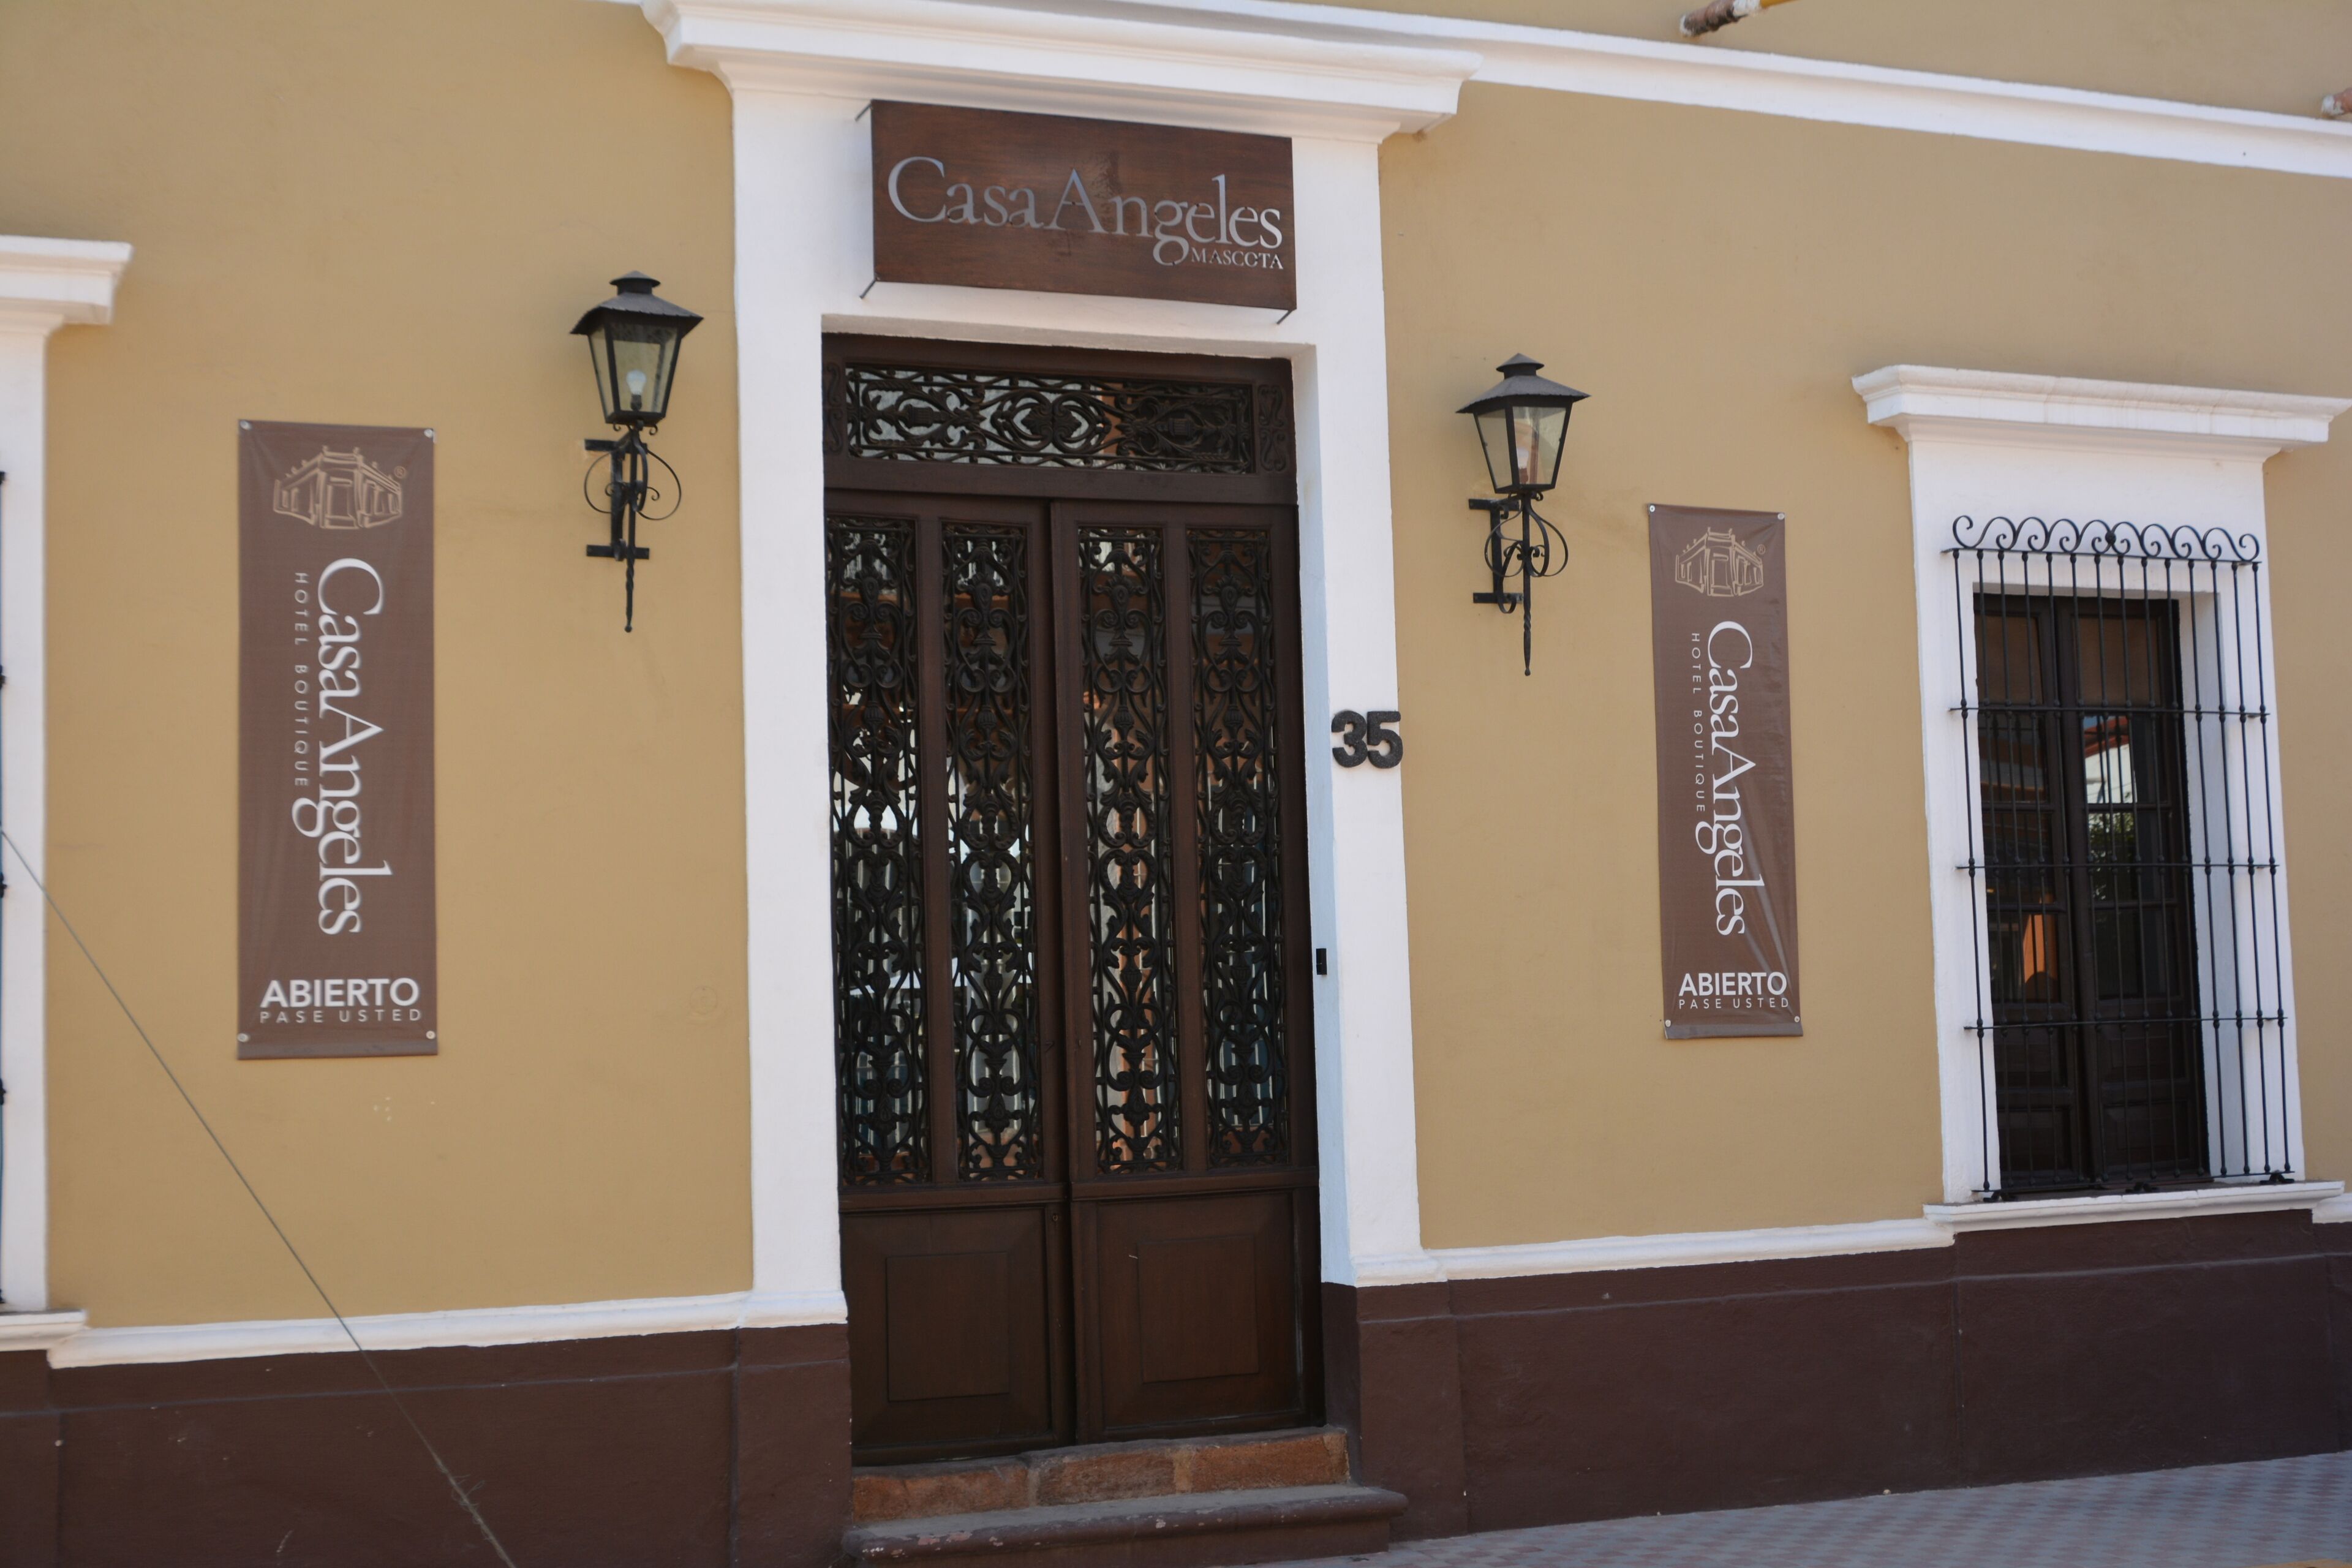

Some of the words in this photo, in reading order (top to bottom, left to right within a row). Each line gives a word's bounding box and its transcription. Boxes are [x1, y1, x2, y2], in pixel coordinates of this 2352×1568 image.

[1191, 246, 1284, 270] MASCOTA
[295, 571, 309, 646] HOTEL
[1691, 633, 1702, 694] HOTEL
[294, 664, 309, 786] BOUTIQUE
[1330, 709, 1403, 769] 35
[1694, 710, 1705, 812] BOUTIQUE
[260, 978, 420, 1008] ABIERTO
[1678, 971, 1787, 997] ABIERTO
[1679, 998, 1722, 1009] PASE
[1733, 997, 1789, 1009] USTED
[260, 1009, 325, 1024] PASE
[339, 1008, 423, 1023] USTED
